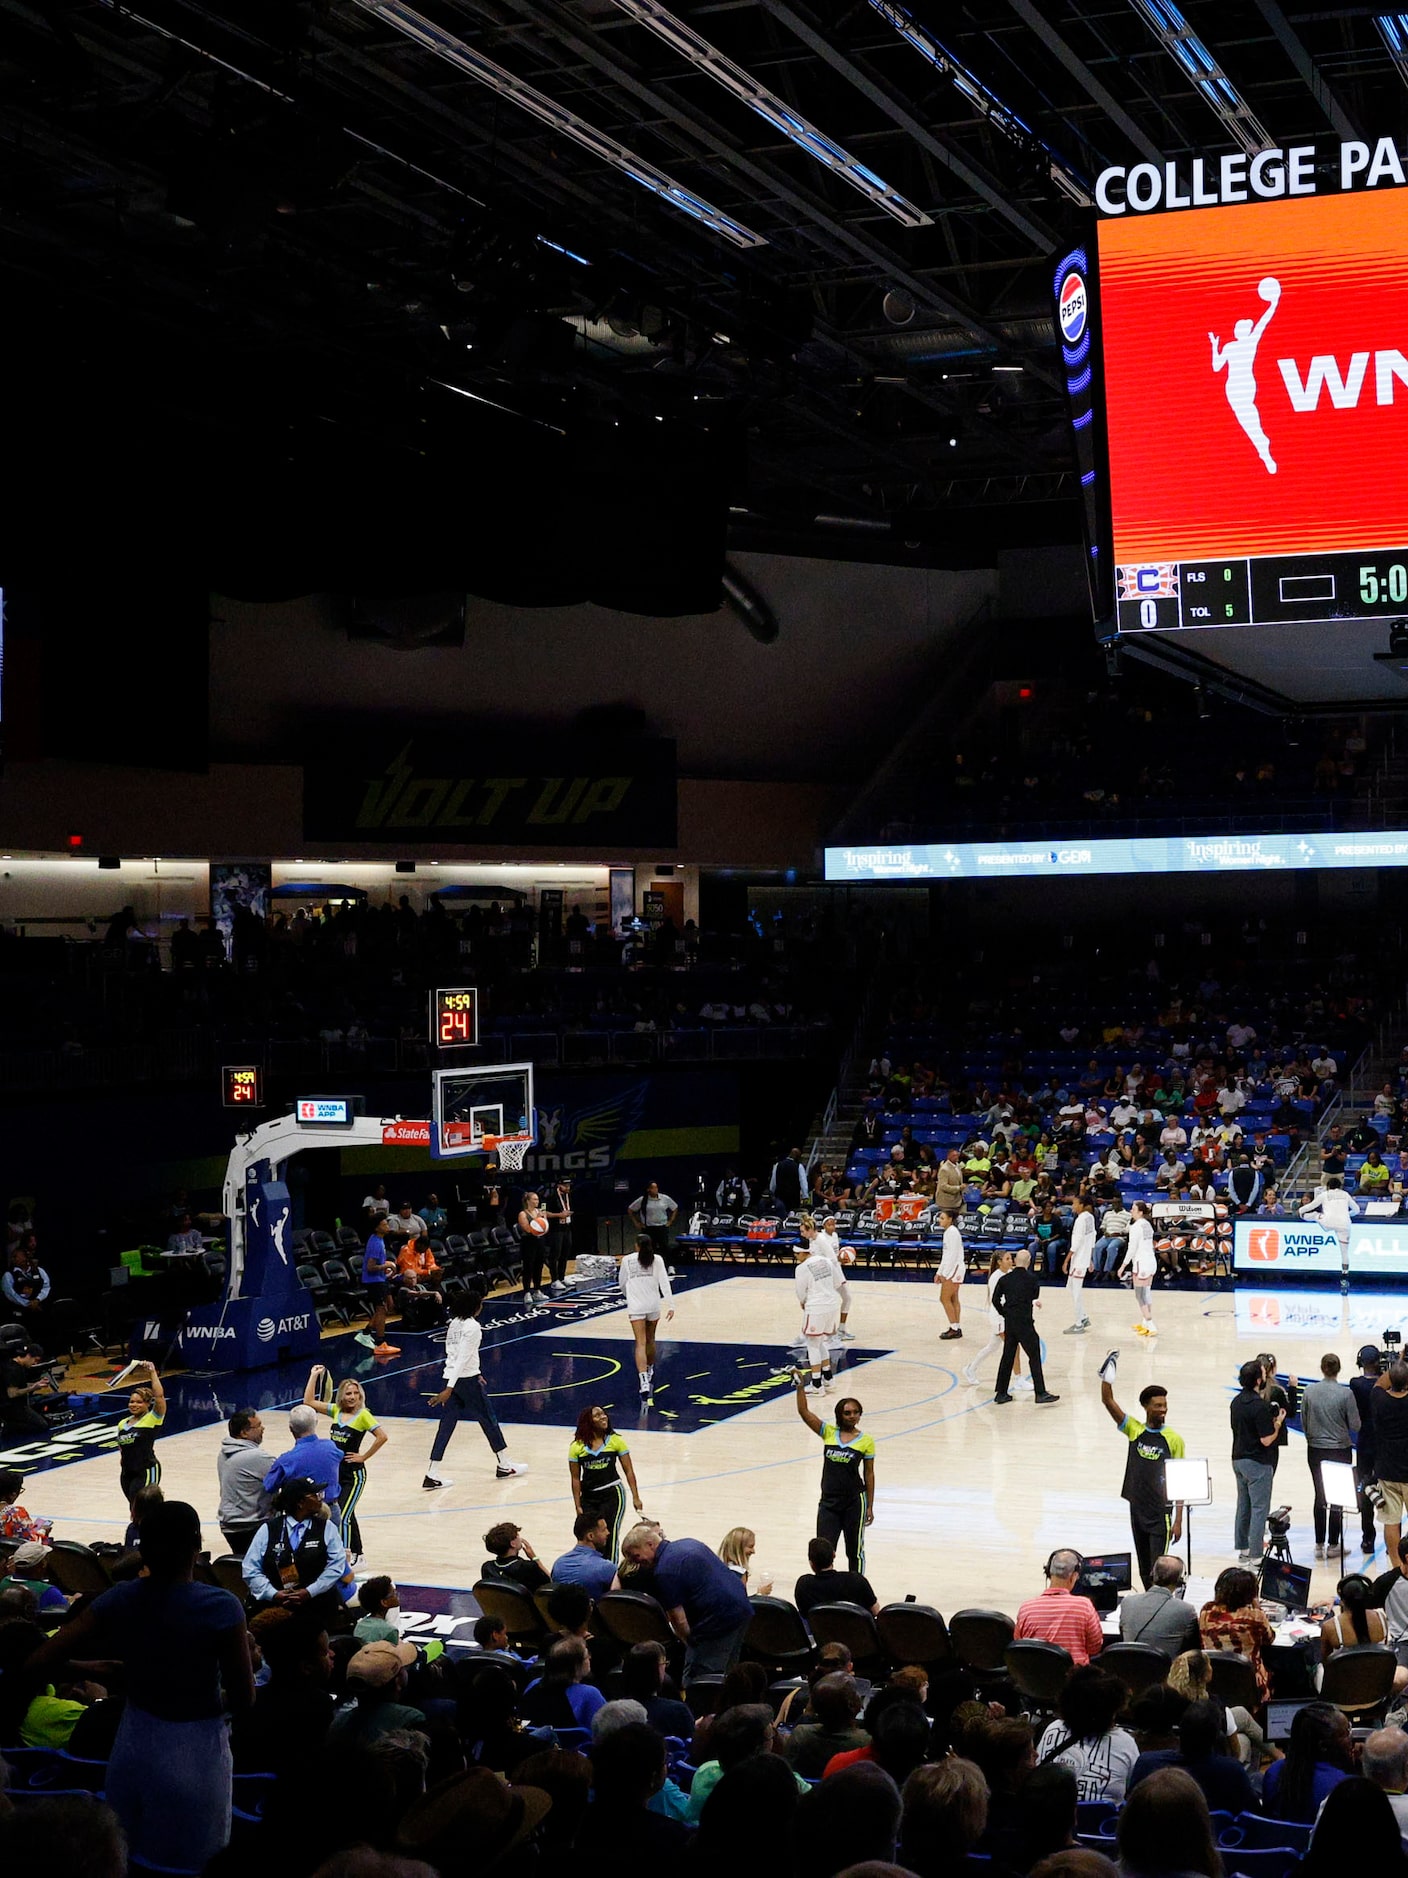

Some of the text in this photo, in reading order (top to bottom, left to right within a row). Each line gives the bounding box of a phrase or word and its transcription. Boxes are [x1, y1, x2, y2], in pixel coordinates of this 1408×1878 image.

[1095, 146, 1316, 215] COLLEGE
[1062, 293, 1085, 321] PEPSI
[1187, 568, 1232, 583] FLS 0
[1140, 599, 1158, 629] 0
[1190, 604, 1234, 617] TOL 5
[354, 735, 635, 829] VOLT UP
[978, 850, 1091, 865] PRESENTED BY GEM
[1186, 840, 1261, 862] Inspiring
[1334, 845, 1394, 856] PRESENTED
[1394, 844, 1408, 854] BY
[843, 850, 911, 871] Inspiring
[445, 995, 470, 1010] 4:59
[442, 1012, 467, 1040] 24
[234, 1072, 255, 1084] 4:59
[234, 1085, 251, 1100] 24
[317, 1104, 344, 1112] WNBA
[397, 1128, 430, 1140] StateFa
[508, 1145, 611, 1172] INGS
[1284, 1235, 1337, 1245] WNBA
[1284, 1246, 1319, 1257] APP
[277, 1313, 310, 1334] AT&T
[186, 1327, 236, 1338] WNBA
